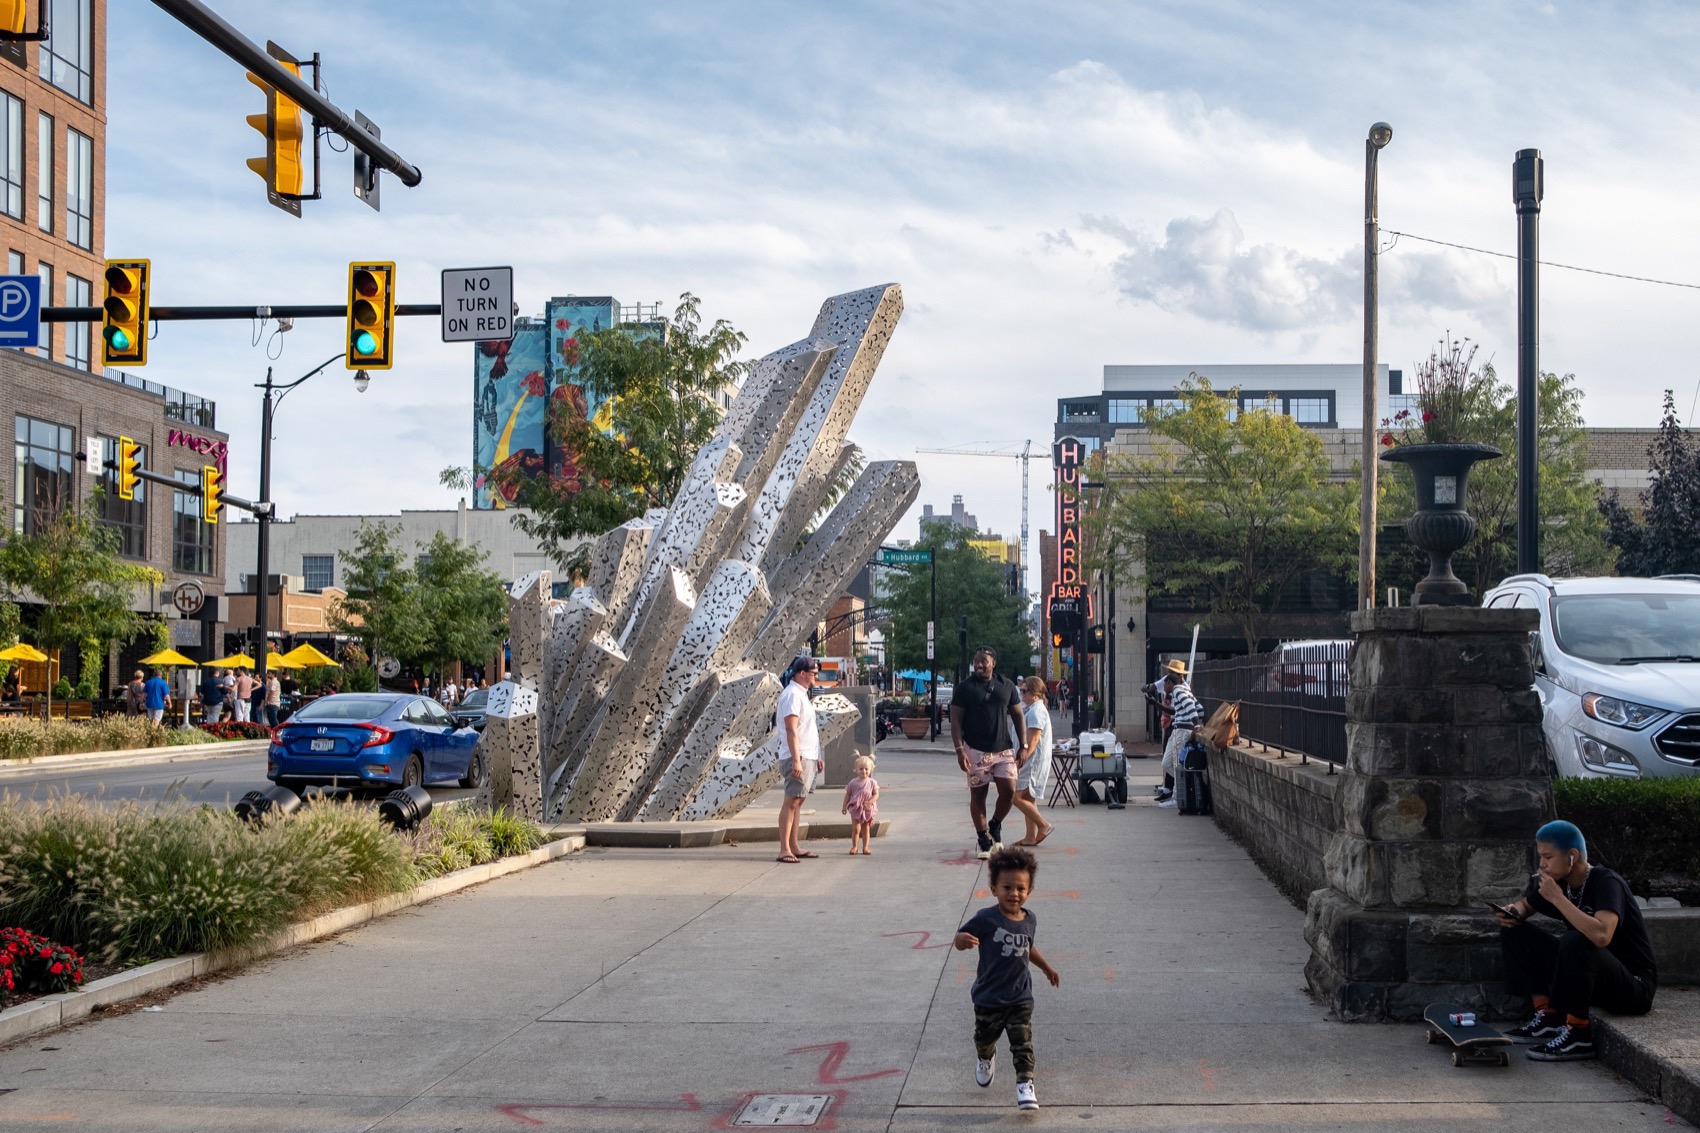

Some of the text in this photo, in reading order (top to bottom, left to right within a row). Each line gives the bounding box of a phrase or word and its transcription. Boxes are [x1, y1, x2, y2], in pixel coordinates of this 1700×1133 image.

[465, 277, 490, 292] NO
[2, 289, 22, 314] P
[457, 296, 497, 312] TURN
[448, 316, 507, 333] ON RED
[891, 553, 920, 561] Hubbard
[1058, 586, 1081, 598] BAR
